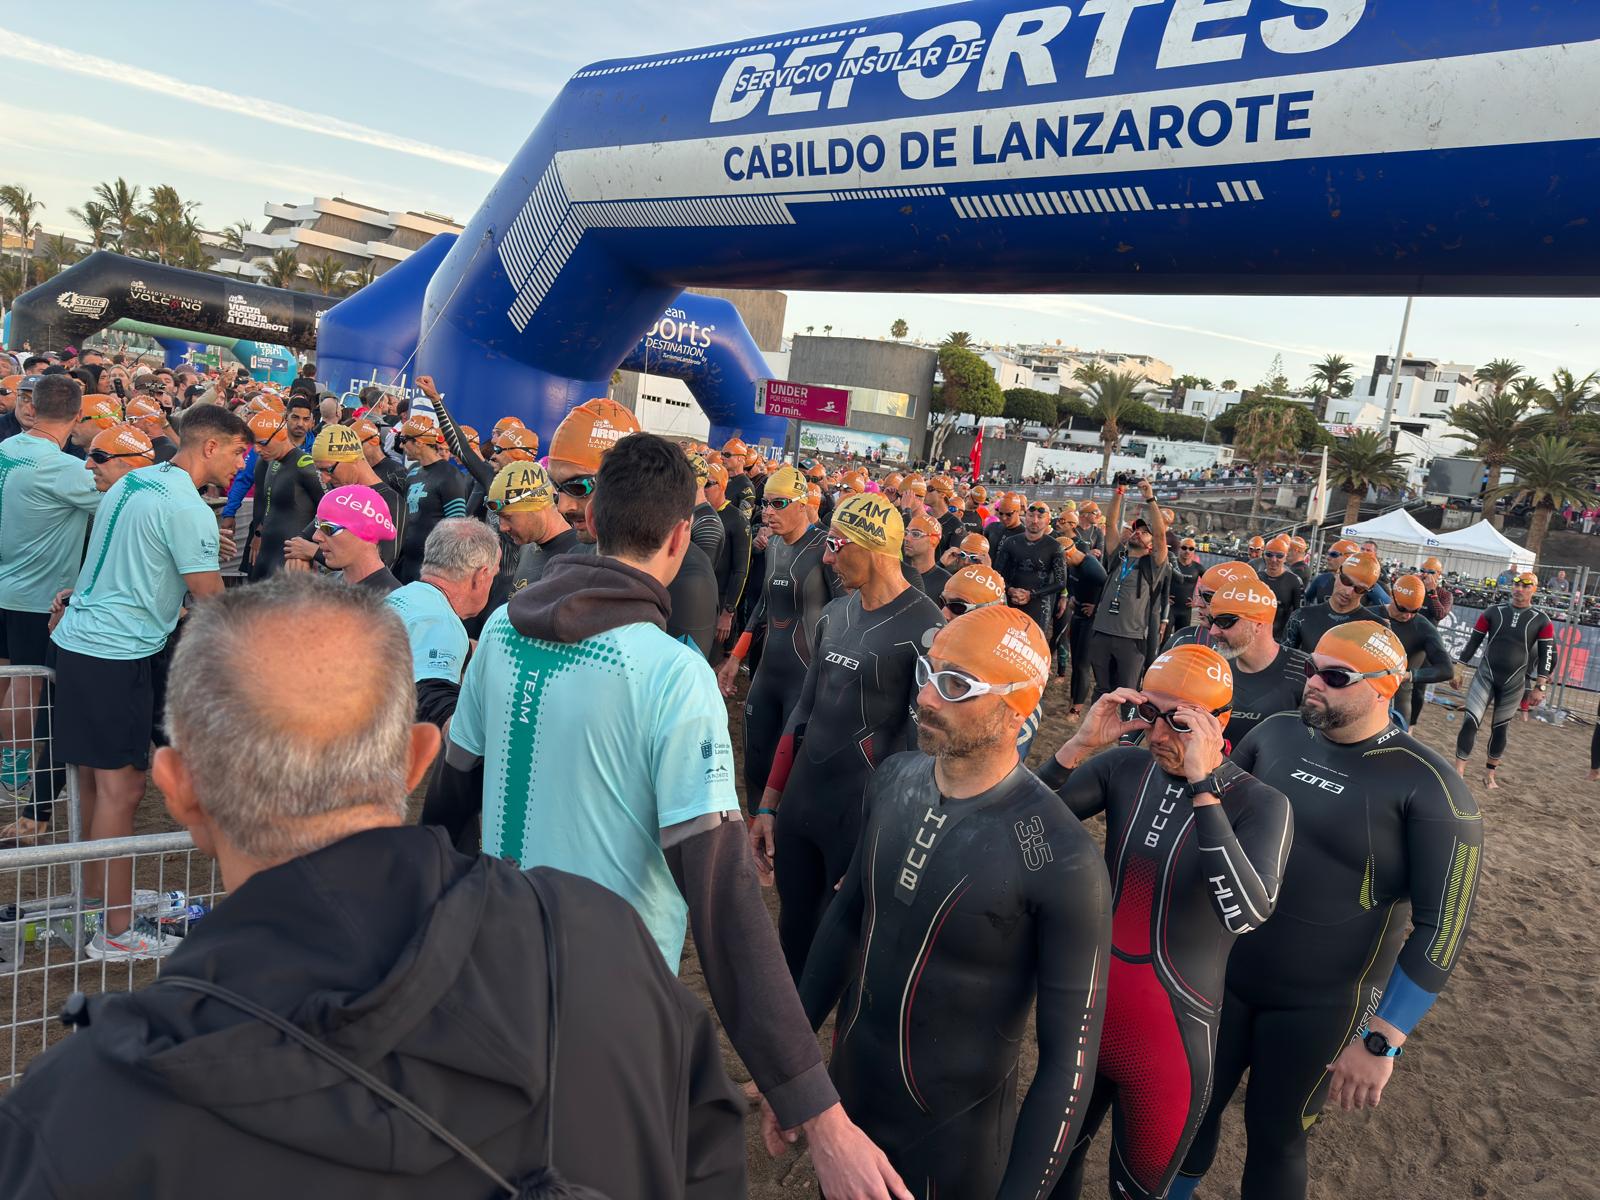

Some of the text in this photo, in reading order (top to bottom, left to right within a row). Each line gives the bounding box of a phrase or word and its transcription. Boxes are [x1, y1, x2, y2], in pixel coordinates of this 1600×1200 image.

[709, 0, 1368, 123] DEPORTES
[734, 39, 986, 92] SERVICIO INSULAR DE
[723, 89, 1314, 182] CABILDO DE LANZAROTE
[75, 297, 104, 307] STAGE
[228, 303, 261, 314] VUELTA
[227, 310, 268, 323] CICLISTA
[664, 307, 686, 320] ean
[236, 317, 289, 333] LANZAROTE
[645, 337, 705, 357] DESTINATION
[770, 383, 808, 398] UNDER
[769, 403, 802, 416] 70 min.
[329, 430, 358, 443] I AM
[506, 468, 545, 487] I AM
[844, 497, 892, 525] I AM
[964, 569, 1003, 600] debo
[825, 651, 860, 671] ZONE3
[996, 643, 1039, 679] LANZARO
[518, 669, 540, 724] TEAM
[1231, 711, 1262, 720] 2XU
[1291, 769, 1345, 795] ZONE3
[1143, 783, 1185, 848] HUUB
[900, 807, 948, 891] HUUB
[1209, 874, 1254, 934] HUU
